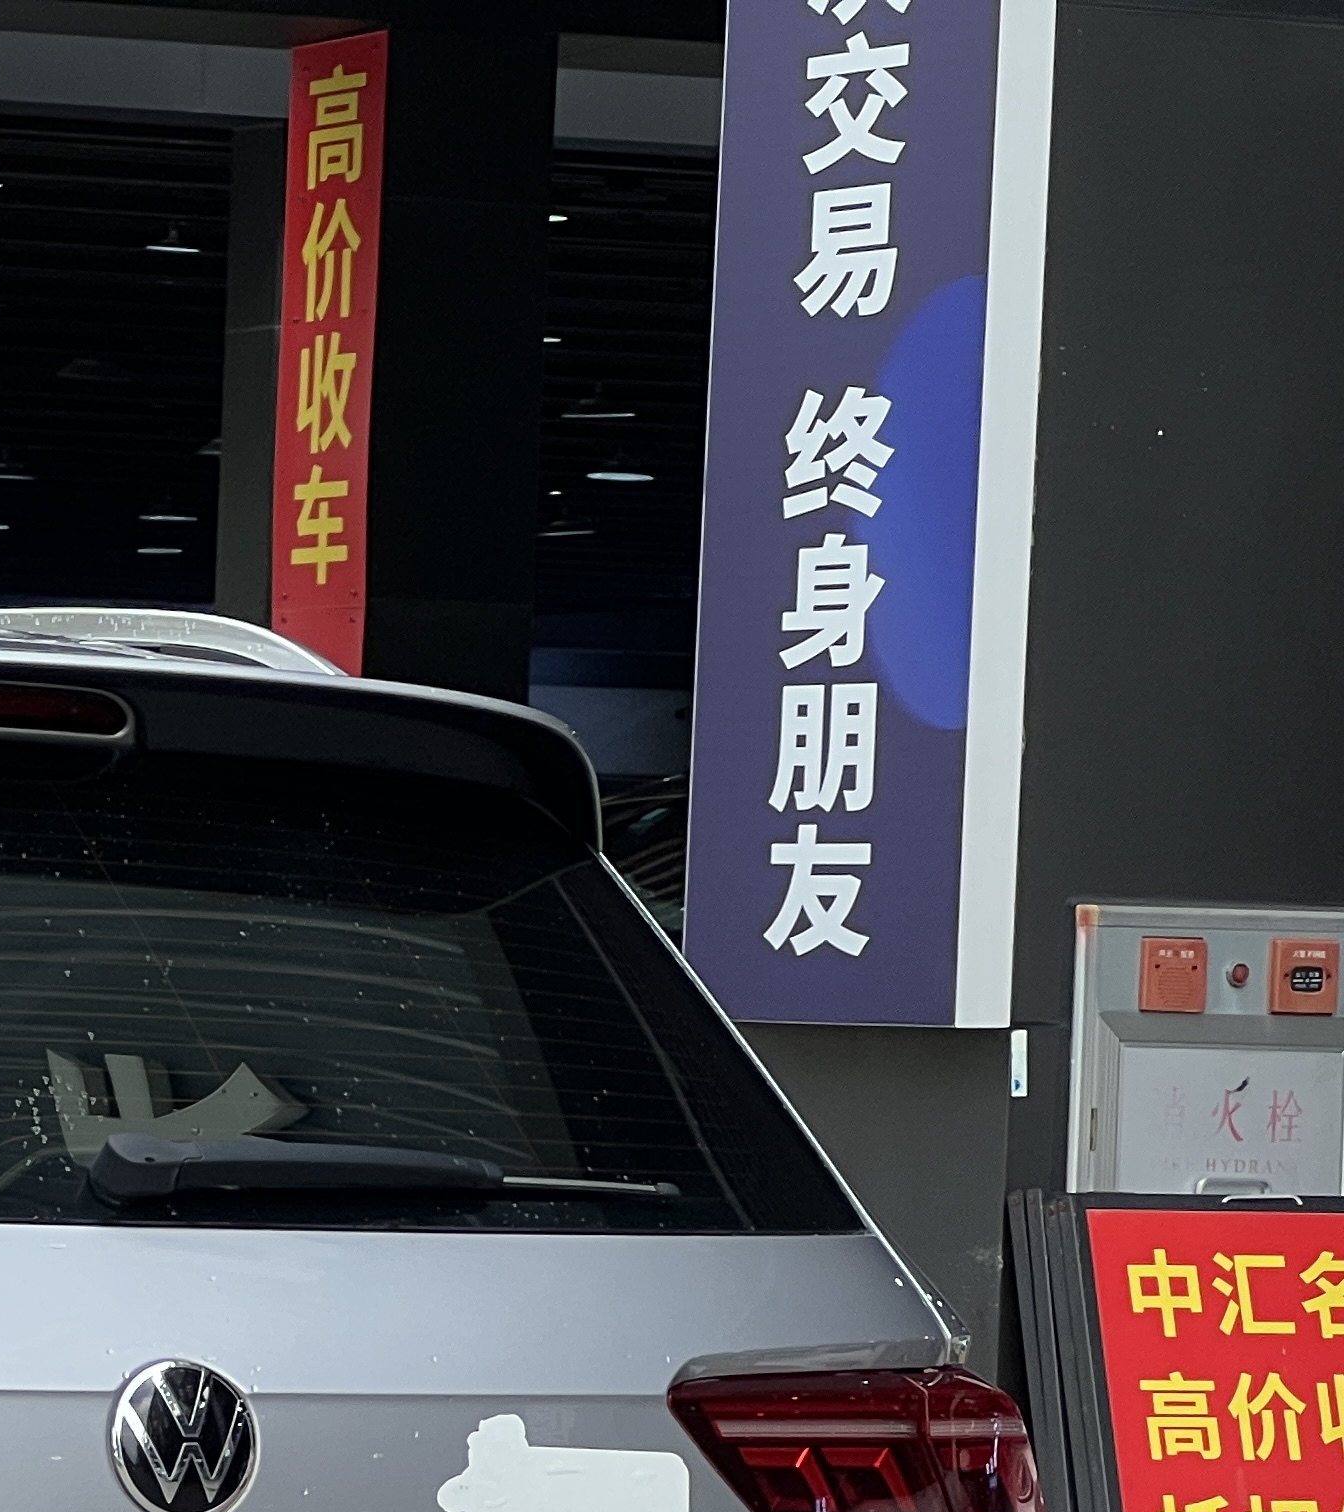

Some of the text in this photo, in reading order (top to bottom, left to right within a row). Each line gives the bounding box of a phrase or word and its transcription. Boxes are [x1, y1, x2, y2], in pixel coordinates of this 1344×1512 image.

[291, 64, 367, 585] 高价收车
[763, 0, 911, 958] 交易 终身朋友
